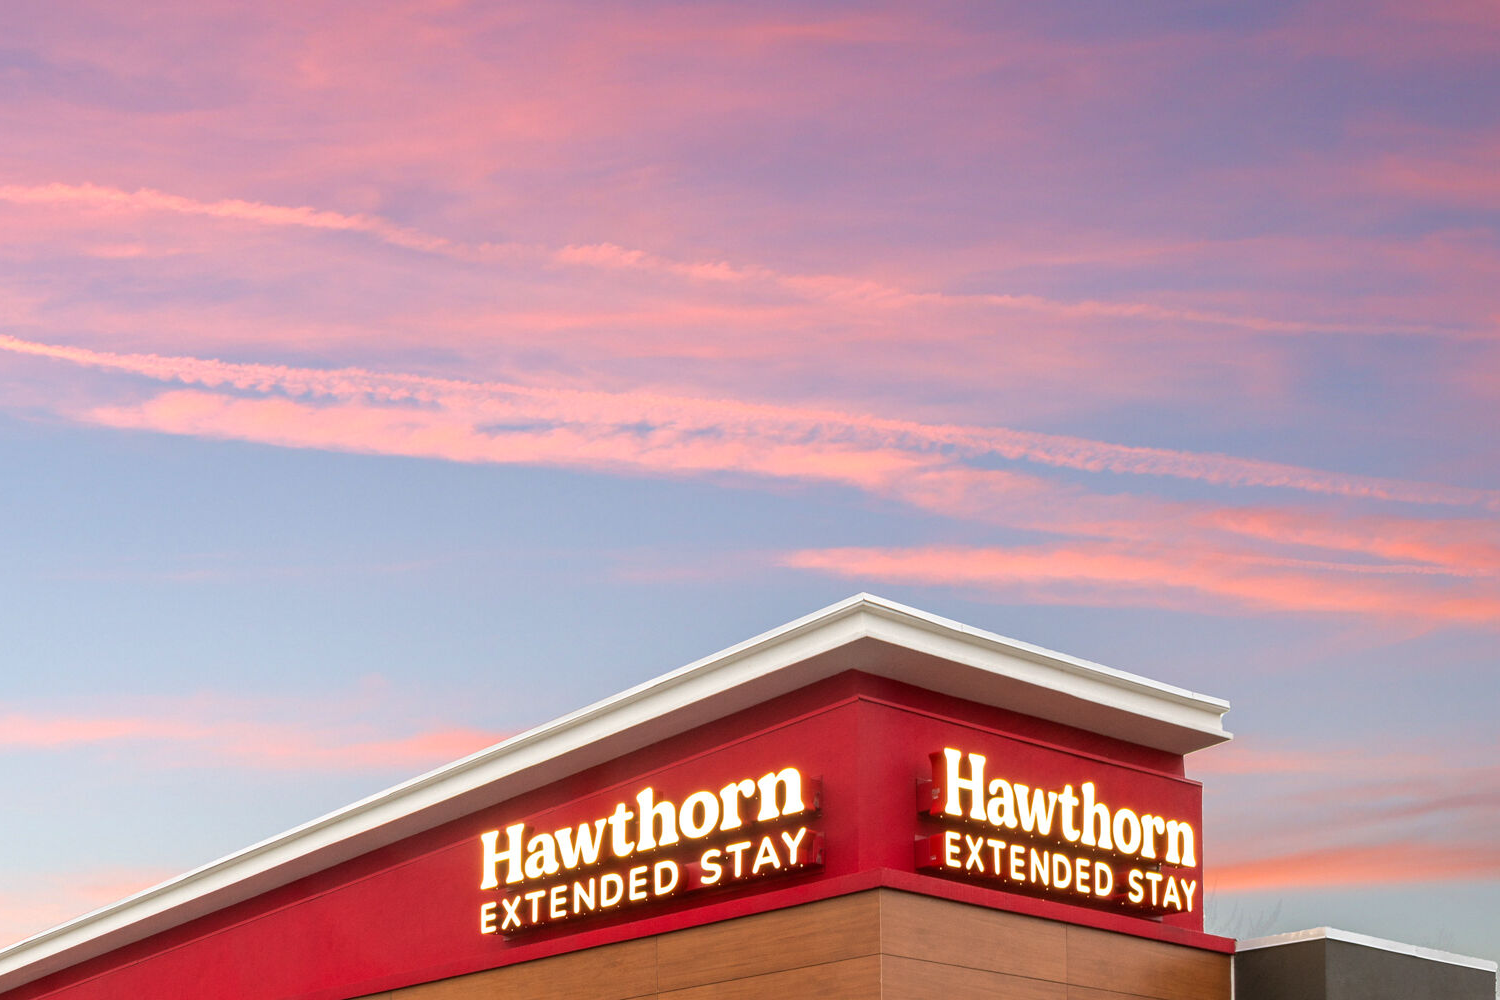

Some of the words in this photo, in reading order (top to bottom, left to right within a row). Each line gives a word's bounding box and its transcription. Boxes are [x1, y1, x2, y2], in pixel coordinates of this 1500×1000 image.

[480, 767, 805, 890] Hawthorn
[943, 746, 1197, 868] Hawthorn
[480, 860, 679, 934] EXTENDED
[700, 827, 807, 885] STAY
[945, 830, 1114, 897] EXTENDED
[1127, 868, 1197, 912] STAY
